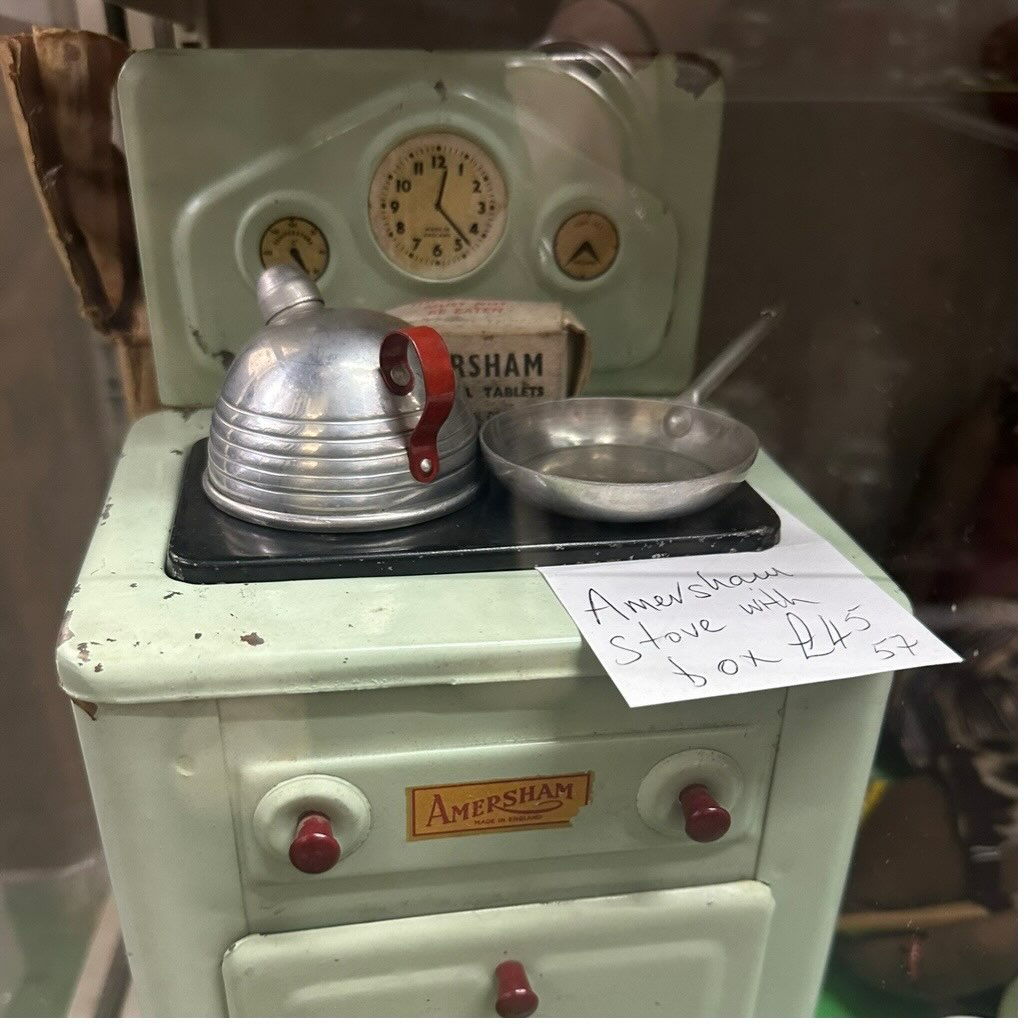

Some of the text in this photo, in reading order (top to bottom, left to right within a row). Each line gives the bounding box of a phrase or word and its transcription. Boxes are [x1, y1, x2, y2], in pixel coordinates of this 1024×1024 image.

[414, 162, 424, 176] 11
[432, 155, 447, 169] 12
[459, 163, 464, 176] 1
[396, 180, 412, 193] 10
[472, 180, 481, 193] 2
[390, 201, 399, 214] 9
[477, 202, 486, 214] 3
[396, 221, 405, 234] 8
[469, 223, 479, 235] 4
[412, 237, 421, 251] 7
[432, 245, 442, 257] 6
[455, 238, 463, 252] 5
[451, 352, 543, 377] RSHAM
[484, 386, 545, 398] TABLETS
[585, 567, 795, 624] Amersham
[739, 587, 820, 616] with
[872, 634, 919, 661] 57
[667, 649, 783, 688] box
[425, 782, 573, 827] AMERSHAM
